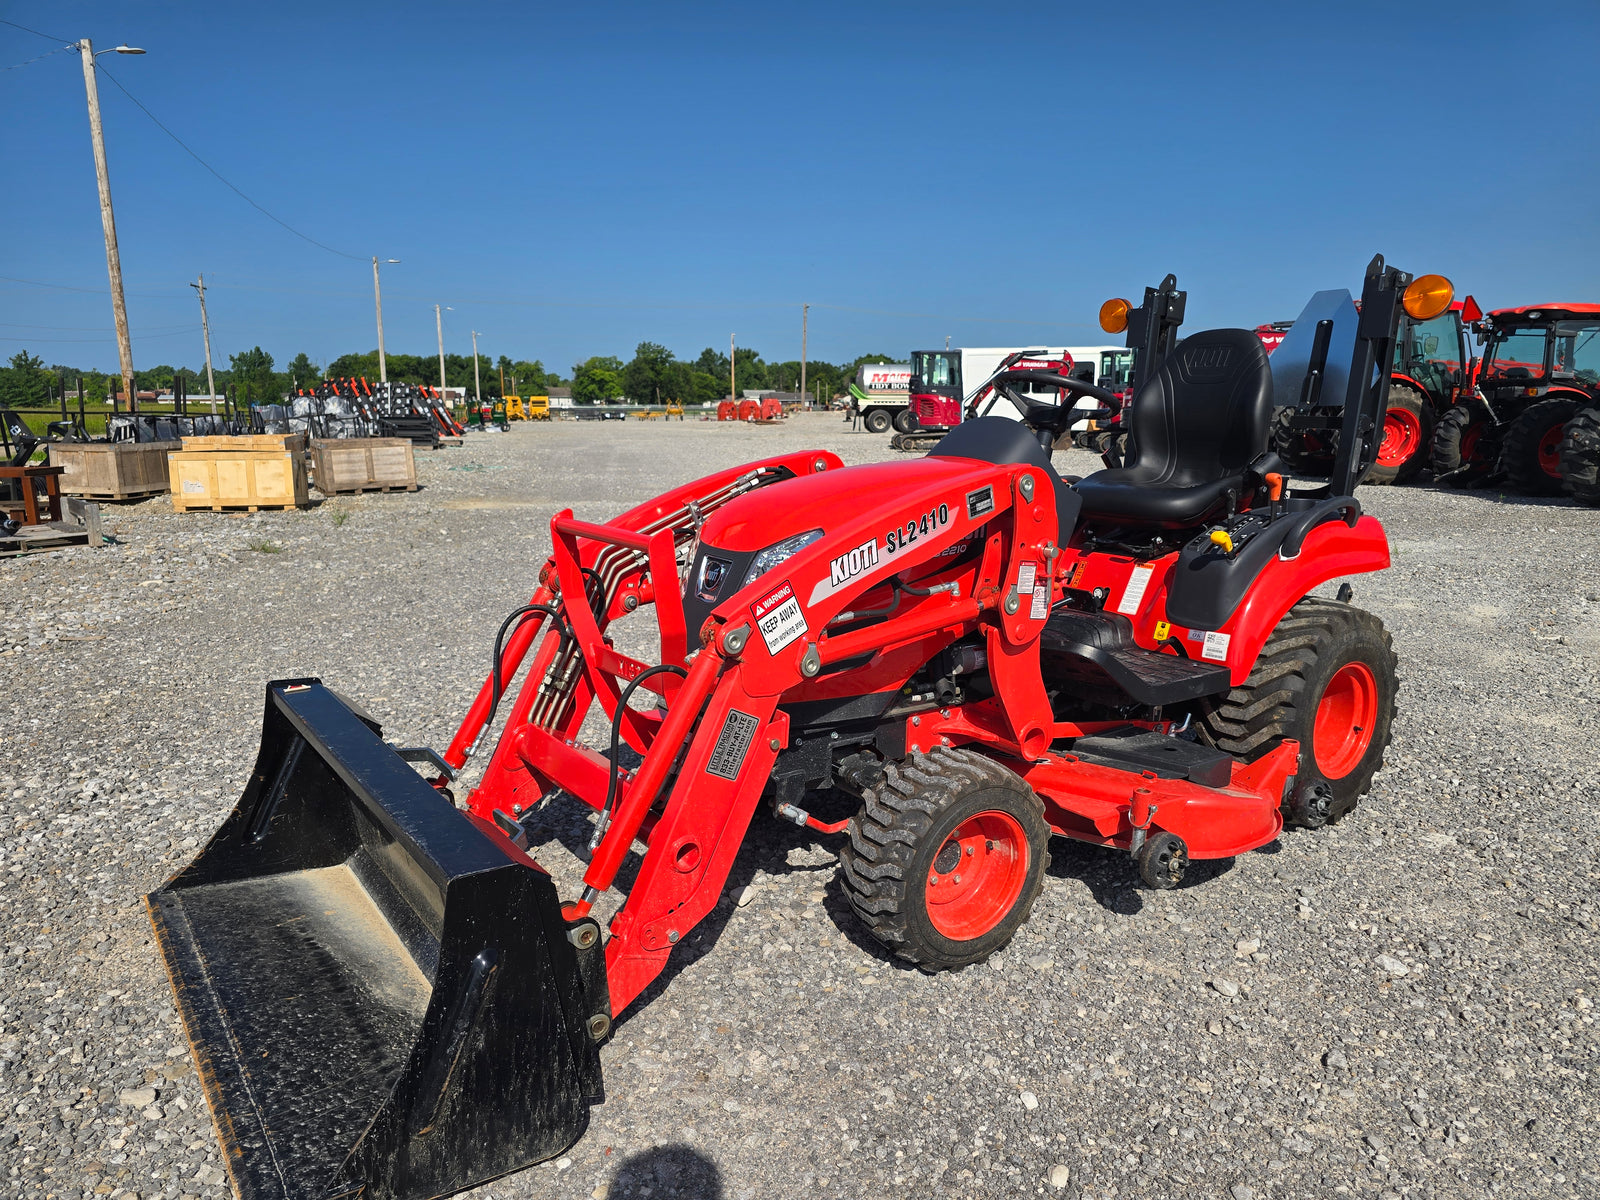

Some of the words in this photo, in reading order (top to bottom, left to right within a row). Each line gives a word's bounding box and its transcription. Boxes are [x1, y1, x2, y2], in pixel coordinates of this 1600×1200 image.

[886, 503, 949, 555] SL2410
[934, 544, 967, 558] 2210
[830, 537, 879, 588] KIOTI
[761, 616, 778, 636] KEEP
[779, 602, 798, 624] AWAY
[762, 586, 791, 609] WARNING
[768, 638, 779, 648] from
[779, 626, 796, 642] working
[795, 620, 804, 630] area
[709, 749, 721, 769] LITTLE
[718, 723, 733, 749] TRACTOR
[719, 716, 747, 773] 833-BUY-AT-LTE
[726, 719, 752, 775] littletractor.com
